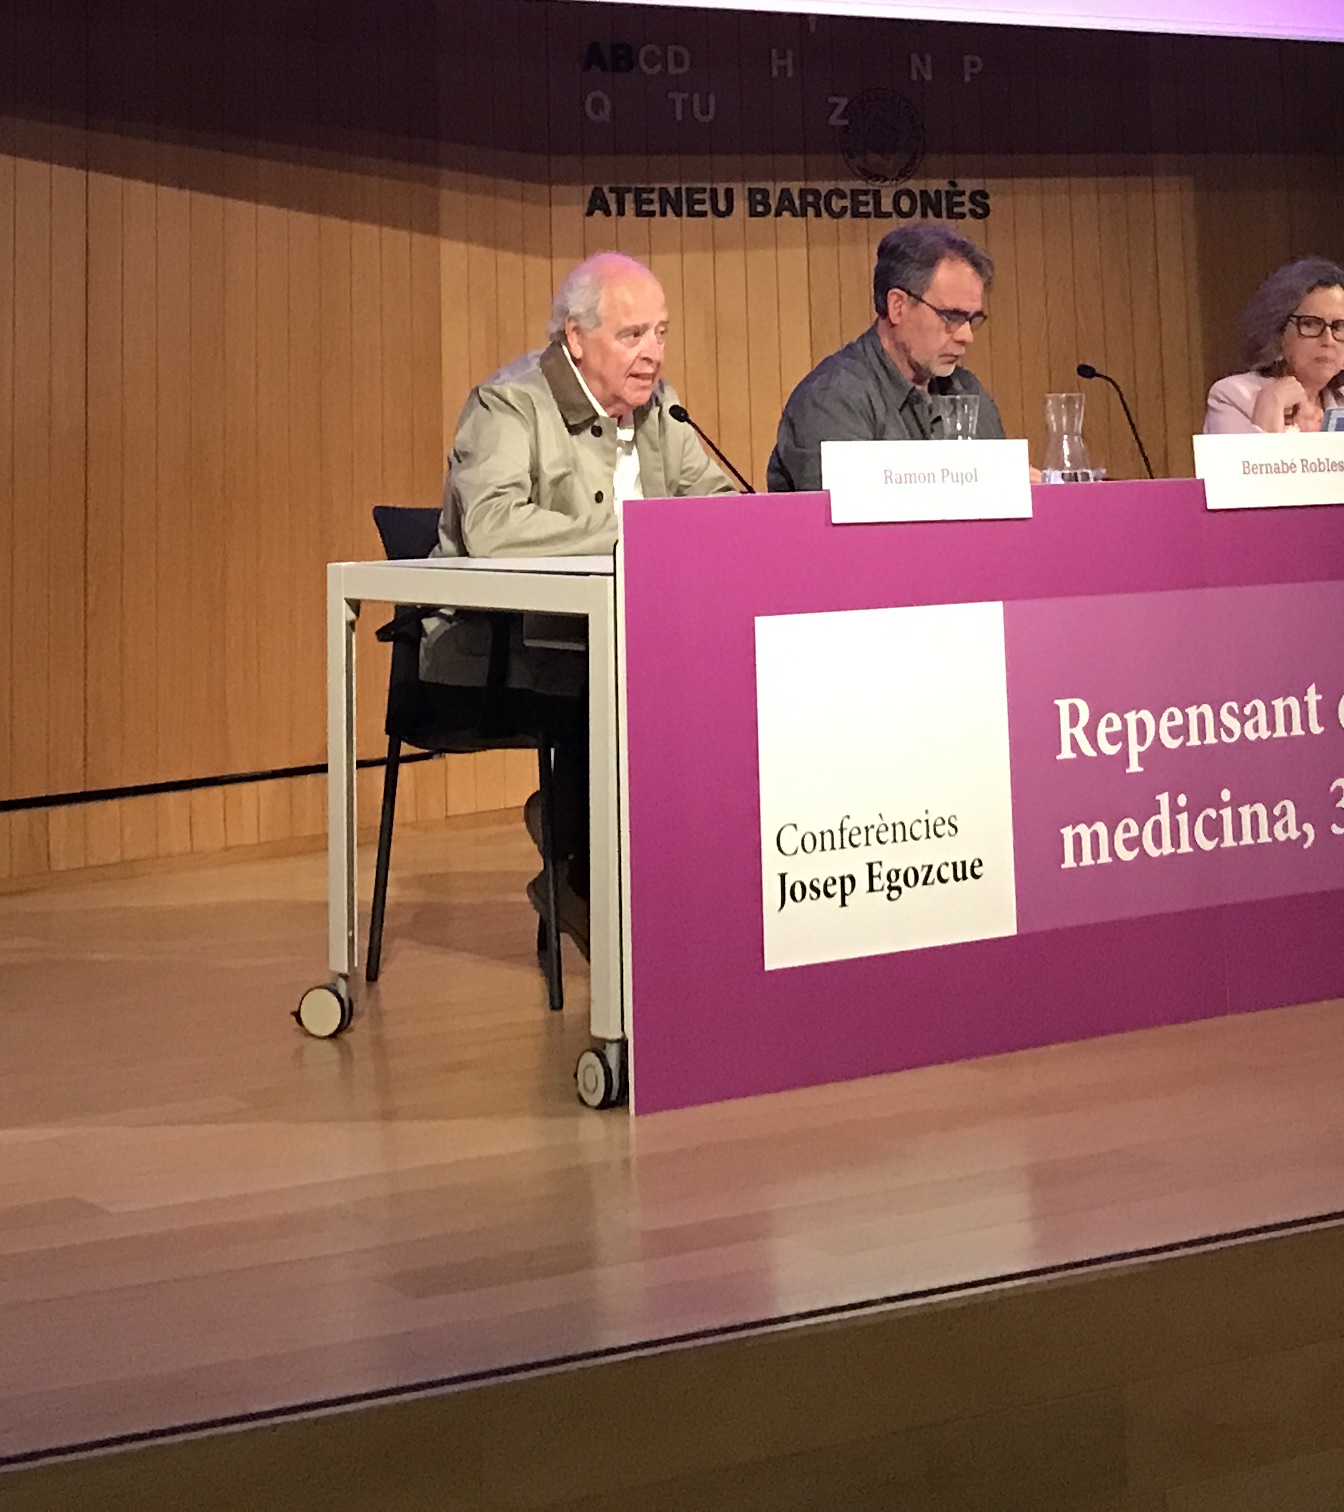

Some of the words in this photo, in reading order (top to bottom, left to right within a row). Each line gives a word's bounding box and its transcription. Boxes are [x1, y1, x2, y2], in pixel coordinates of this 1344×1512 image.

[586, 186, 734, 218] ATENEU
[748, 181, 991, 219] BARCELONÈS
[883, 469, 936, 485] Ramon
[941, 468, 978, 486] Pujol
[1242, 458, 1297, 475] Bernabé
[1300, 458, 1344, 473] Robles
[1054, 683, 1324, 774] Repensant
[776, 809, 959, 857] Conferències
[1060, 788, 1315, 869] medicina,
[777, 871, 856, 912] Josep
[865, 856, 984, 902] Egozcue
